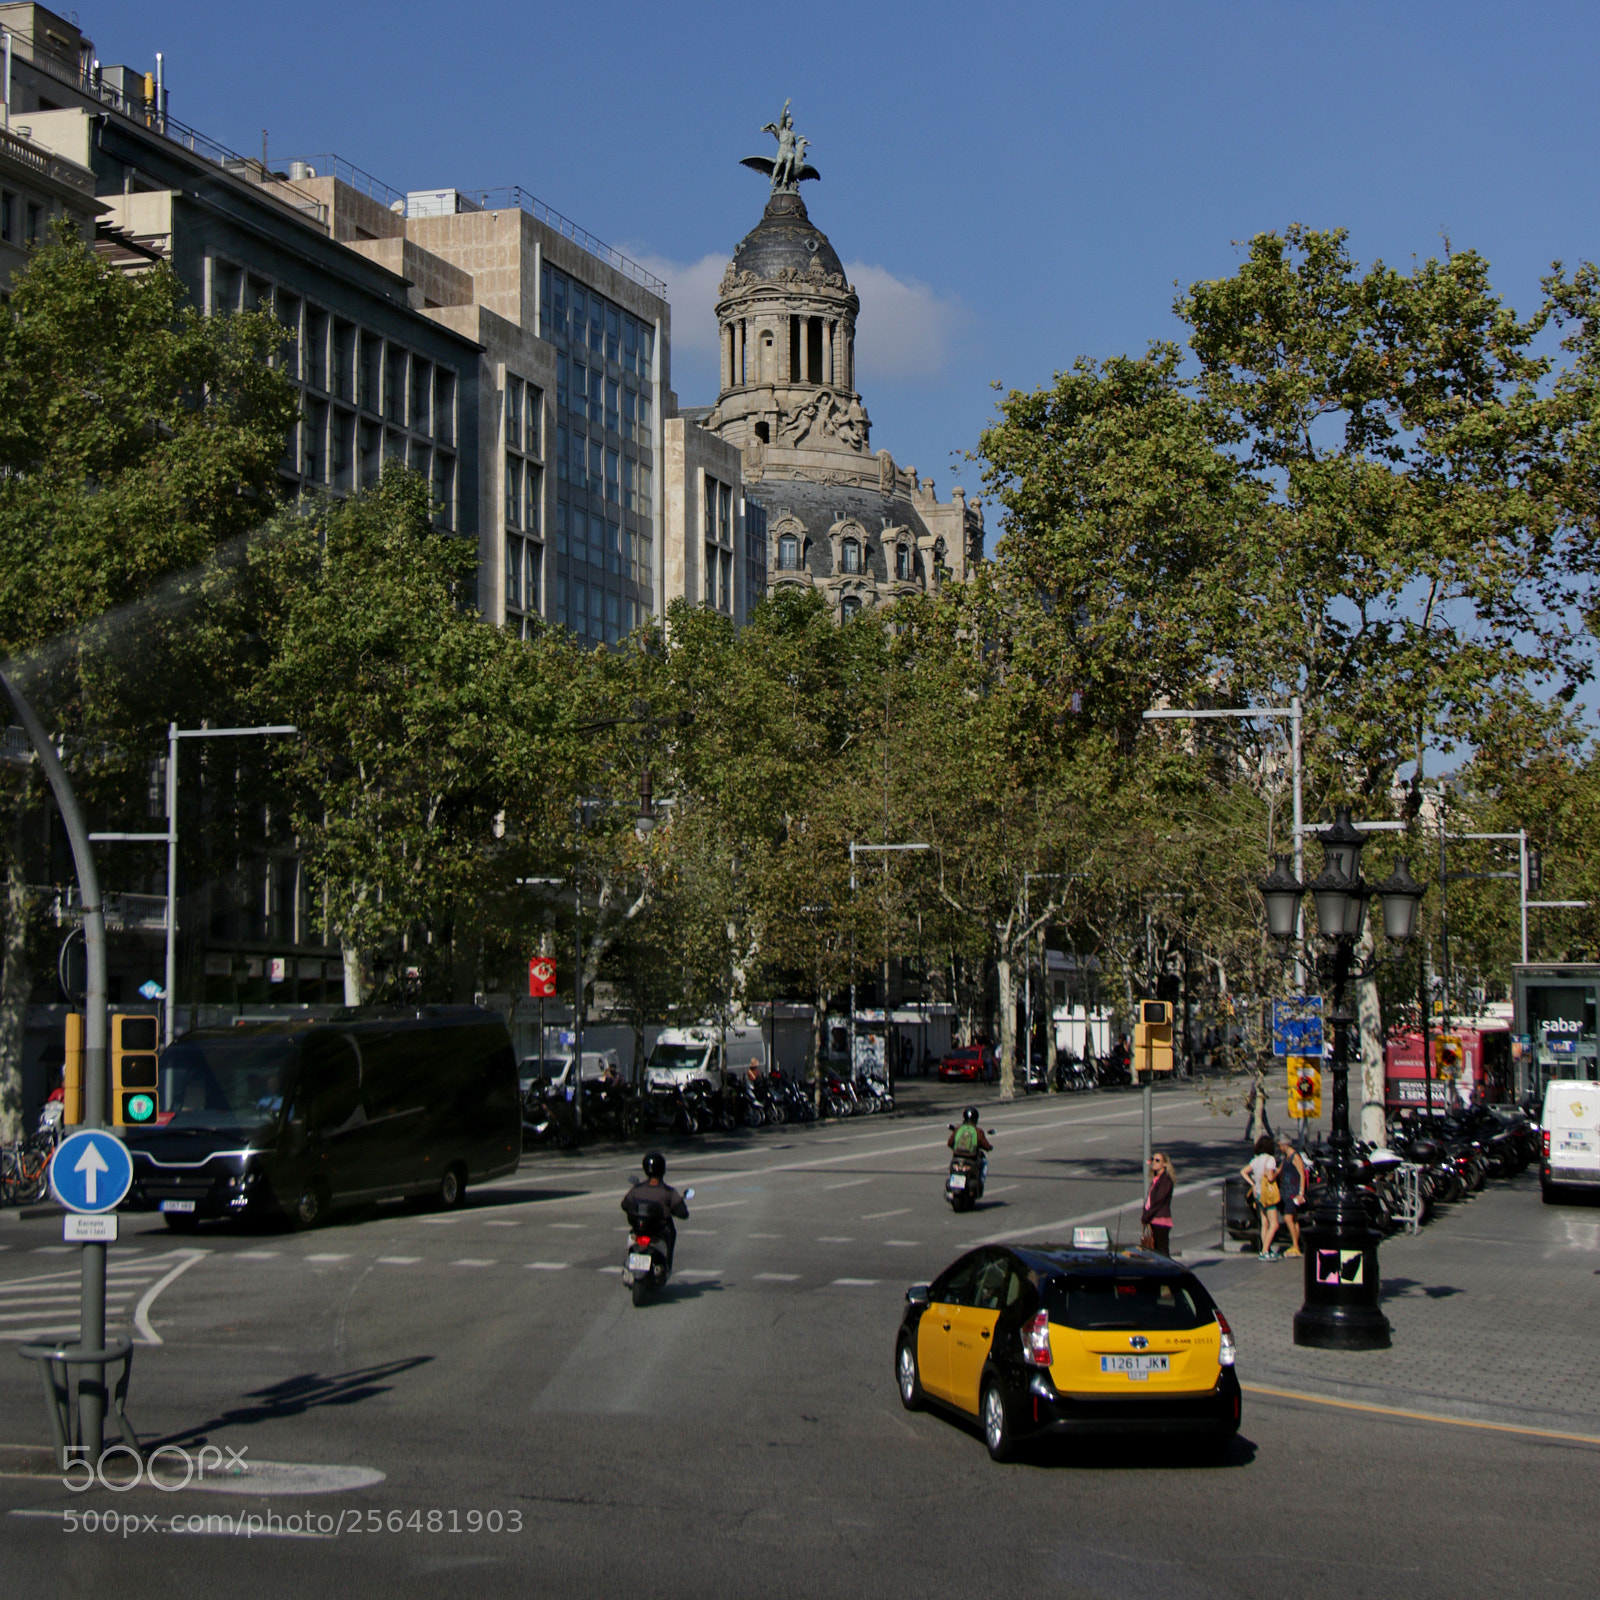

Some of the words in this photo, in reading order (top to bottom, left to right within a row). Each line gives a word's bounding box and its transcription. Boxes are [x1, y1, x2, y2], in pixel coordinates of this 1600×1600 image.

[1541, 1017, 1578, 1032] saba
[1111, 1357, 1140, 1369] 1261
[1145, 1357, 1168, 1369] JKW
